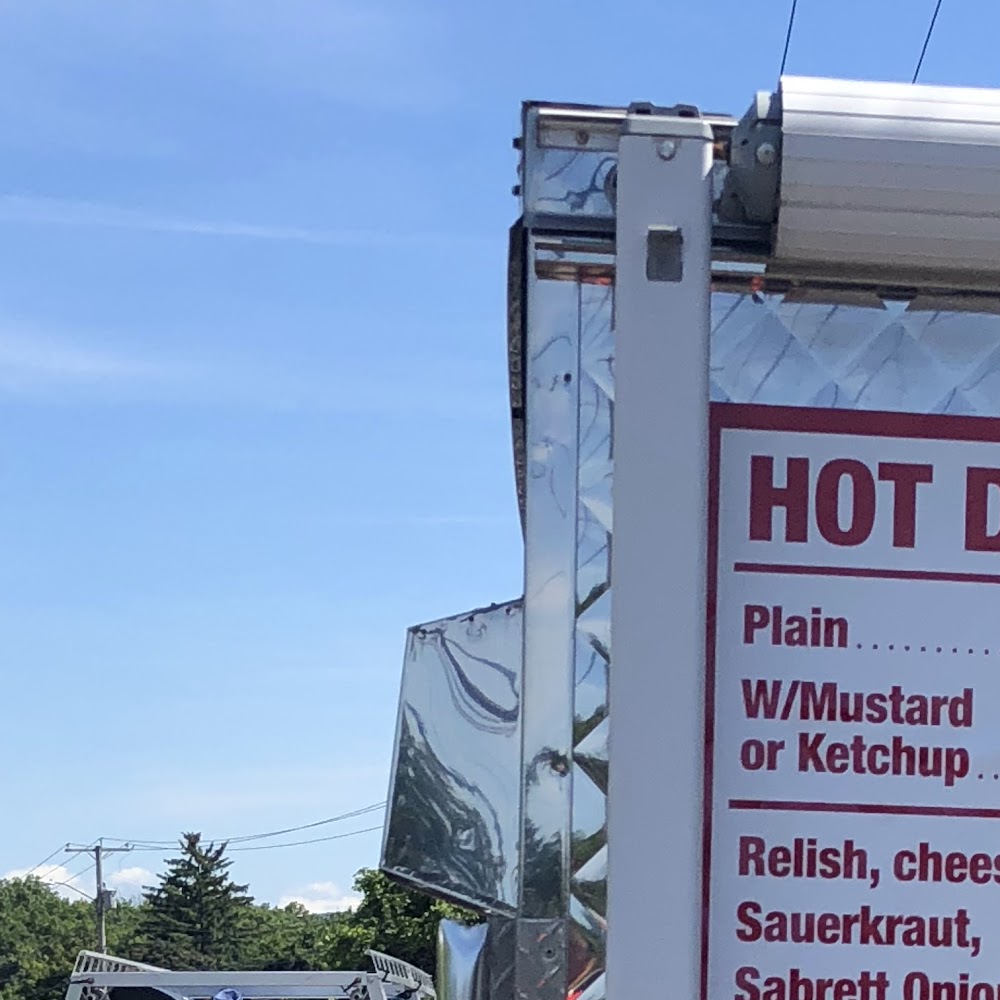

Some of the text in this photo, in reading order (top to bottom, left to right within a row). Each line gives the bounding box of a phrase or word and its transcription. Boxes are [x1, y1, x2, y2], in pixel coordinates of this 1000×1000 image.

[748, 455, 934, 549] HOT
[743, 604, 849, 648] Plain
[742, 679, 973, 728] W/Mustard
[740, 739, 785, 771] or
[798, 732, 970, 787] Ketchup
[738, 836, 880, 889] Relish,
[736, 901, 981, 957] Sauerkraut,
